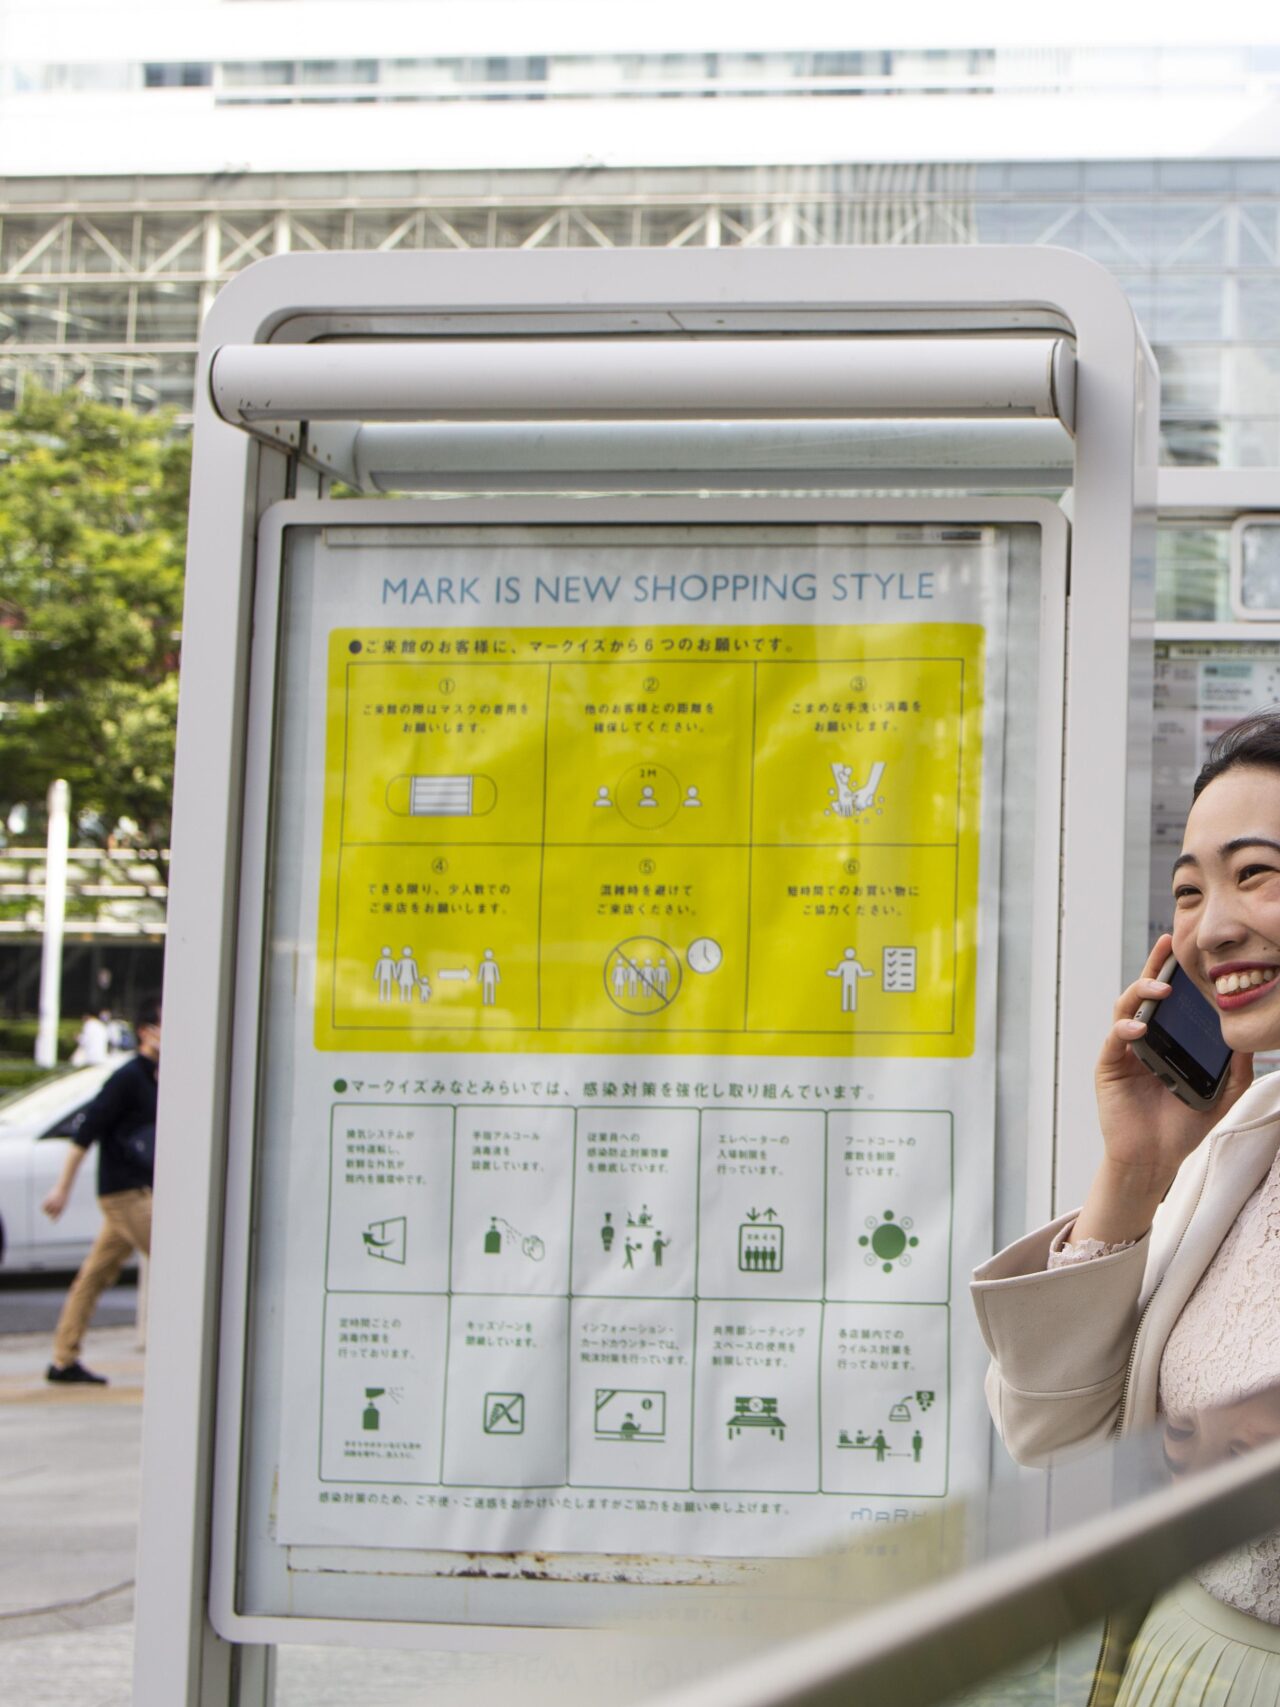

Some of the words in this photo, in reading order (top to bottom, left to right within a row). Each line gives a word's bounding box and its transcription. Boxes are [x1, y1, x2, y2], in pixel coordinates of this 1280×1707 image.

[382, 577, 480, 604] MARK
[495, 576, 521, 604] IS
[536, 573, 621, 603] NEW
[635, 573, 816, 602] SHOPPING
[834, 573, 934, 600] STYLE
